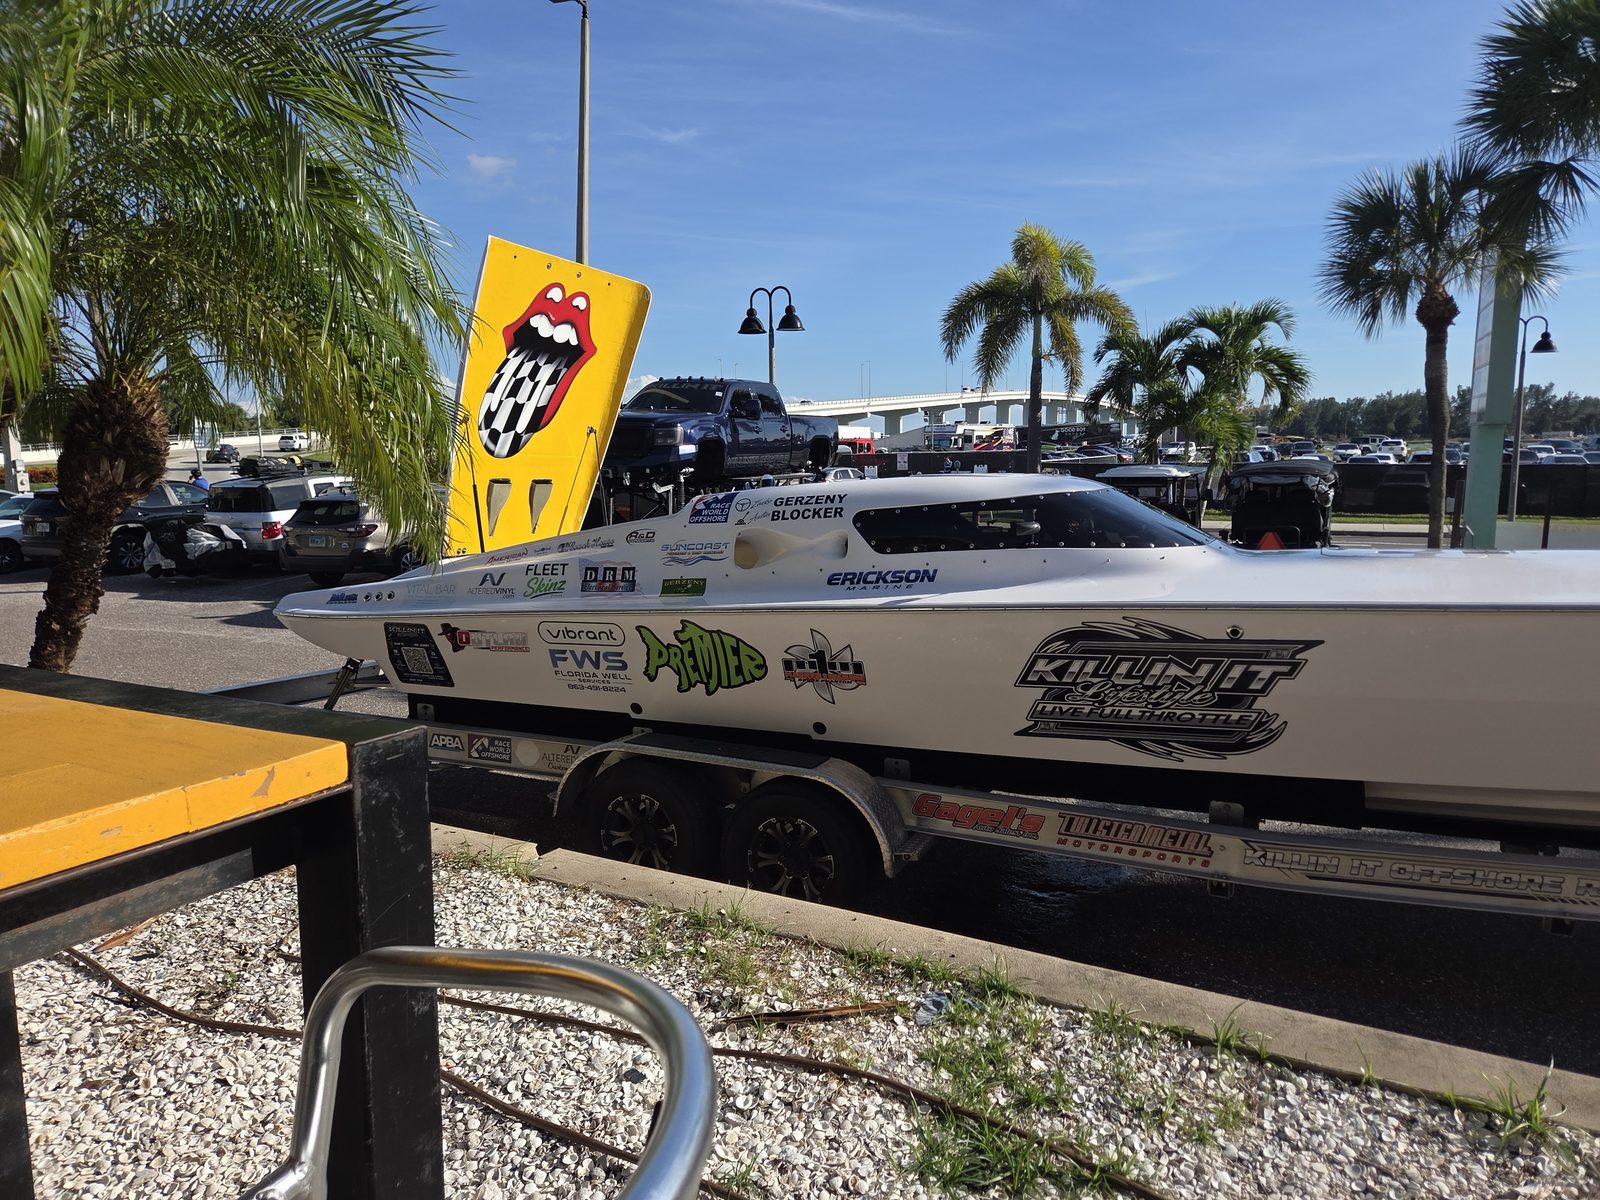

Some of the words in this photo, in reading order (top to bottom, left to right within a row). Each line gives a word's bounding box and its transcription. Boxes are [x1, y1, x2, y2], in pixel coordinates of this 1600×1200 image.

[773, 493, 849, 507] GERZENY
[689, 515, 727, 523] OFFSHORE
[701, 508, 729, 516] WORLD
[770, 507, 845, 521] BLOCKER
[629, 531, 656, 539] R&D
[661, 542, 731, 552] SUNCOAST
[485, 547, 529, 565] AMERICAN
[525, 563, 569, 576] FLEET
[664, 579, 704, 587] GERZENY
[827, 569, 938, 586] ERICKSON
[523, 576, 567, 598] Skinz
[845, 583, 914, 591] MARINE
[546, 626, 617, 641] vibrant
[548, 649, 628, 671] FWS
[635, 619, 768, 696] PREMIER
[554, 670, 599, 679] FLORIDA
[601, 672, 632, 680] WELL
[1023, 655, 1217, 691] KILLIN
[1219, 662, 1298, 692] IT
[1064, 678, 1219, 709] Lifestyle
[1038, 704, 1088, 717] LIVE
[1089, 706, 1137, 719] FULL
[1138, 709, 1253, 726] THROTTLE
[429, 733, 464, 750] APBA
[494, 740, 511, 748] RACE
[480, 752, 511, 761] OFFSHORE
[488, 746, 511, 754] WORLD
[542, 753, 578, 764] ALTERED
[912, 793, 1046, 833] Gagel's
[1056, 837, 1211, 868] MOTORSPORTS
[1243, 848, 1340, 874] KILLIN
[1349, 858, 1383, 878] IT
[1389, 862, 1566, 895] OFFSHORE
